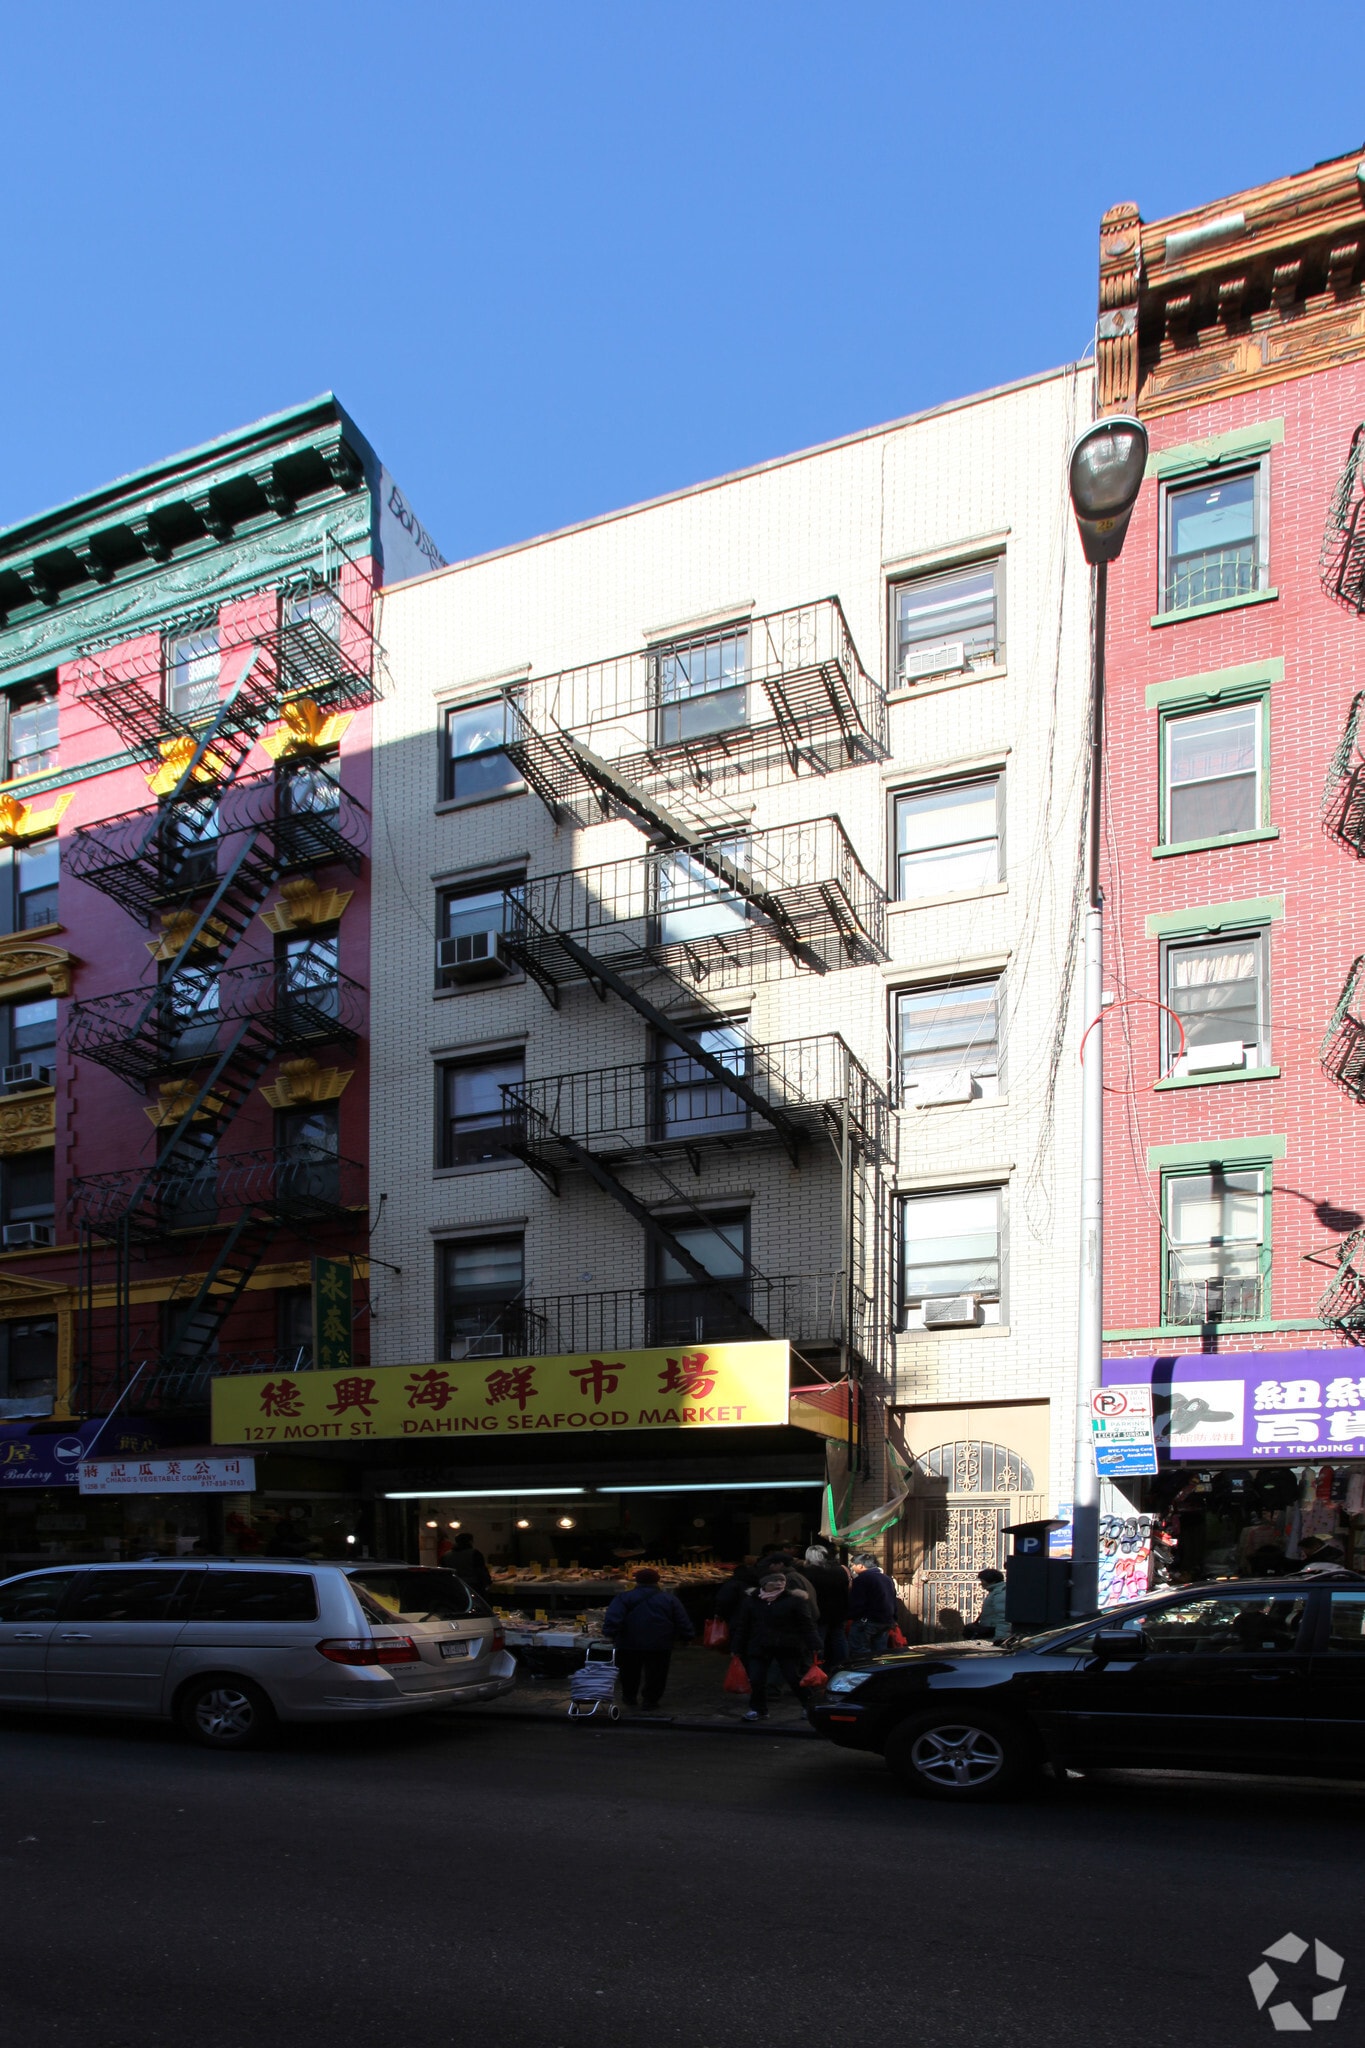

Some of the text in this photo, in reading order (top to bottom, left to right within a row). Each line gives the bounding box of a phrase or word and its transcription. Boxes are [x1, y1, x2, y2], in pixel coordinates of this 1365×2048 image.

[1097, 520, 1114, 531] 25
[259, 1353, 718, 1417] 德興海鮮市場
[244, 1406, 747, 1441] 127 MOTT ST. DAHING SEAFOOD MARKET
[1252, 1446, 1281, 1454] NTT
[1287, 1444, 1354, 1453] TRADING
[3, 1469, 52, 1482] Bakery
